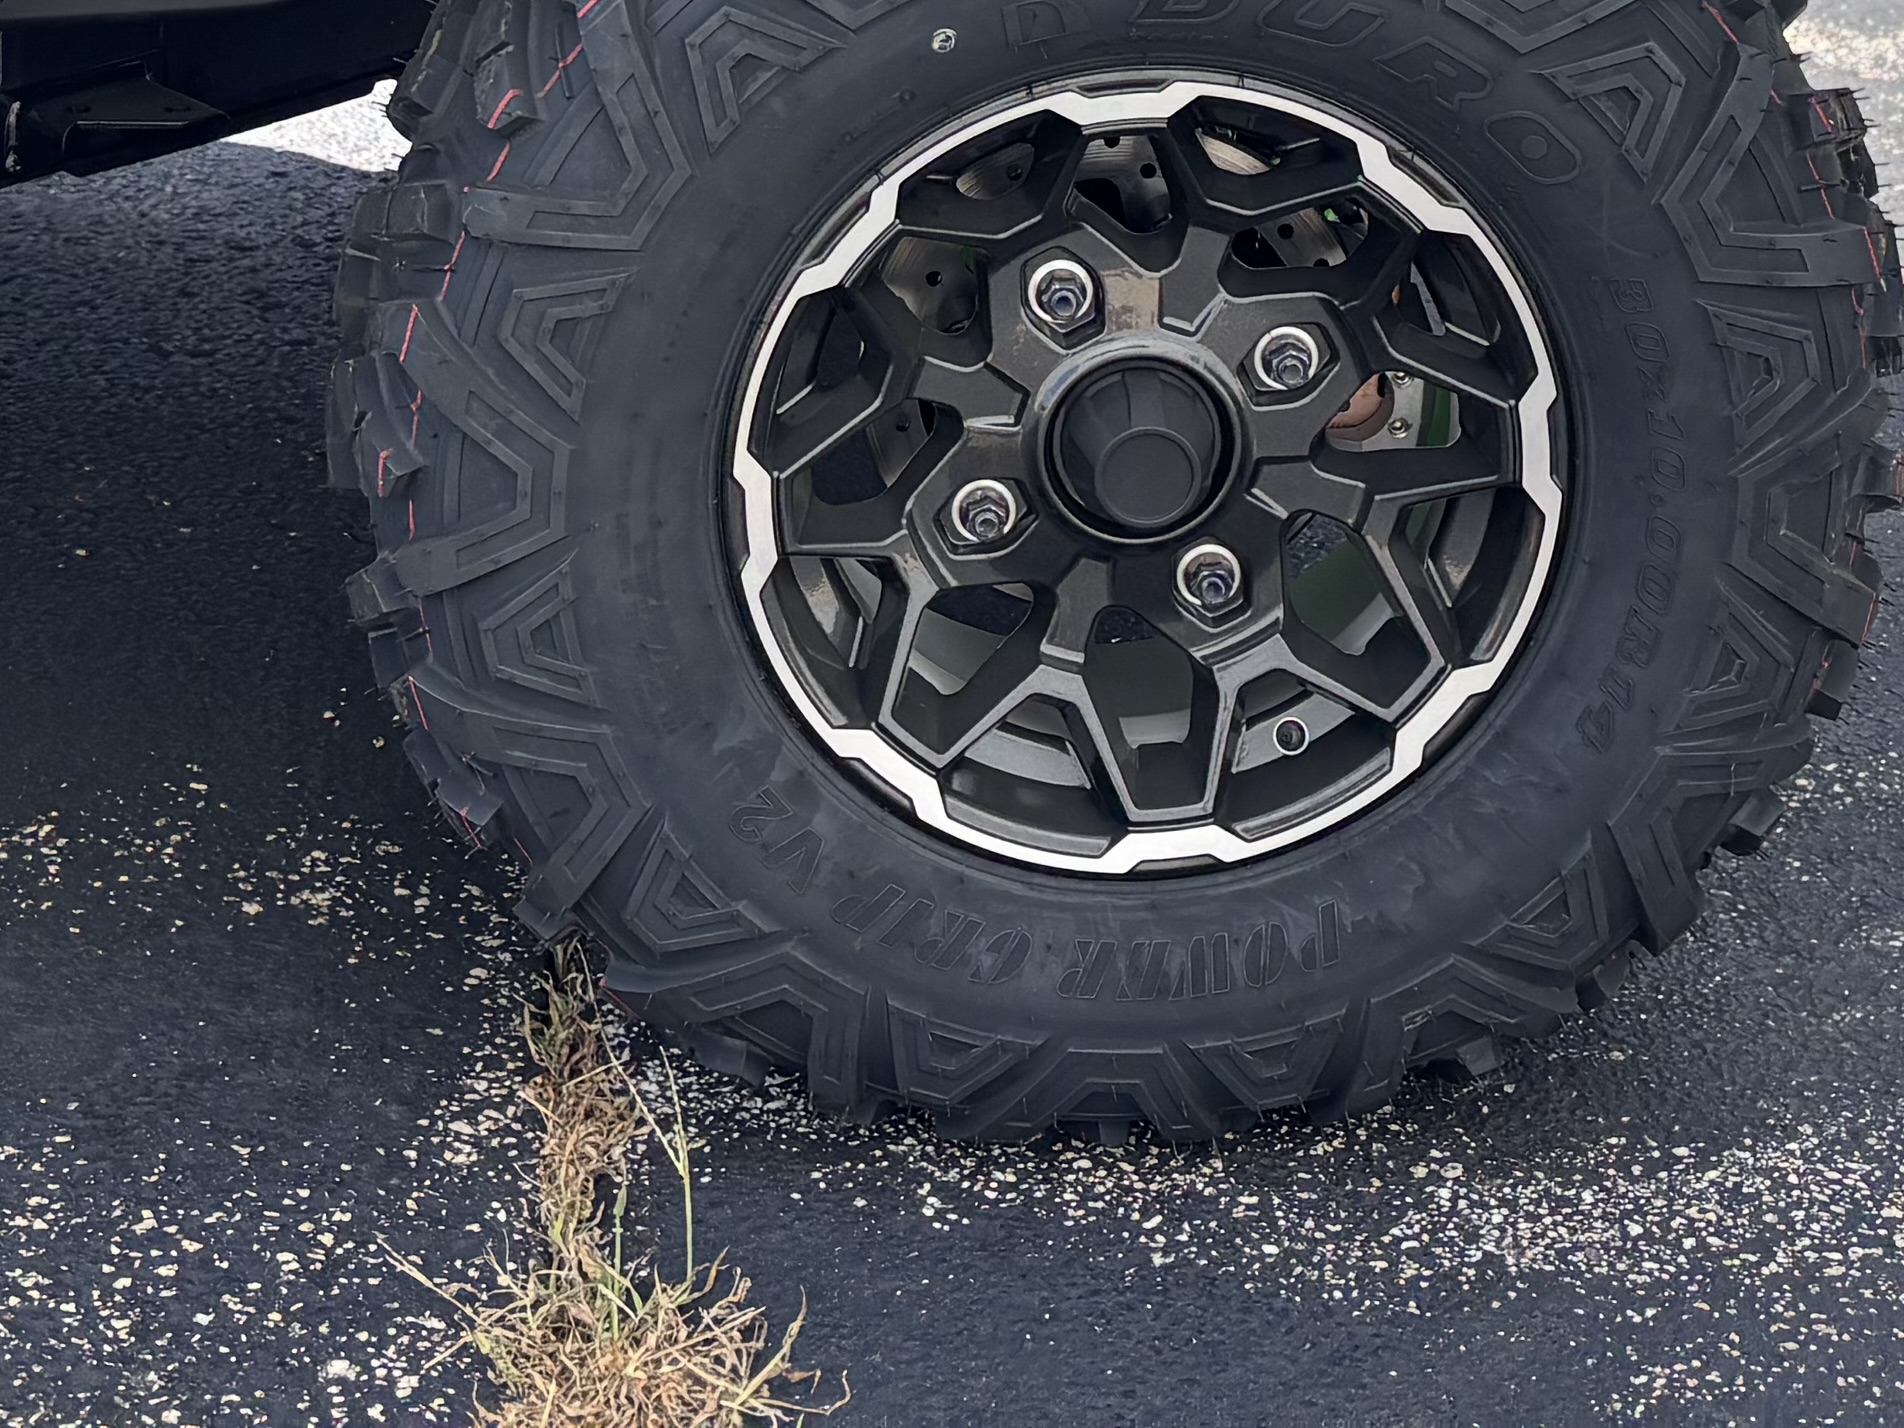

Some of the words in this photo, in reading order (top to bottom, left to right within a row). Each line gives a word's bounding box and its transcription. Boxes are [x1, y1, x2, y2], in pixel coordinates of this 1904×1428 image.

[727, 784, 826, 895] V2
[829, 883, 1033, 985] GRIP
[1056, 899, 1341, 1002] POWER
